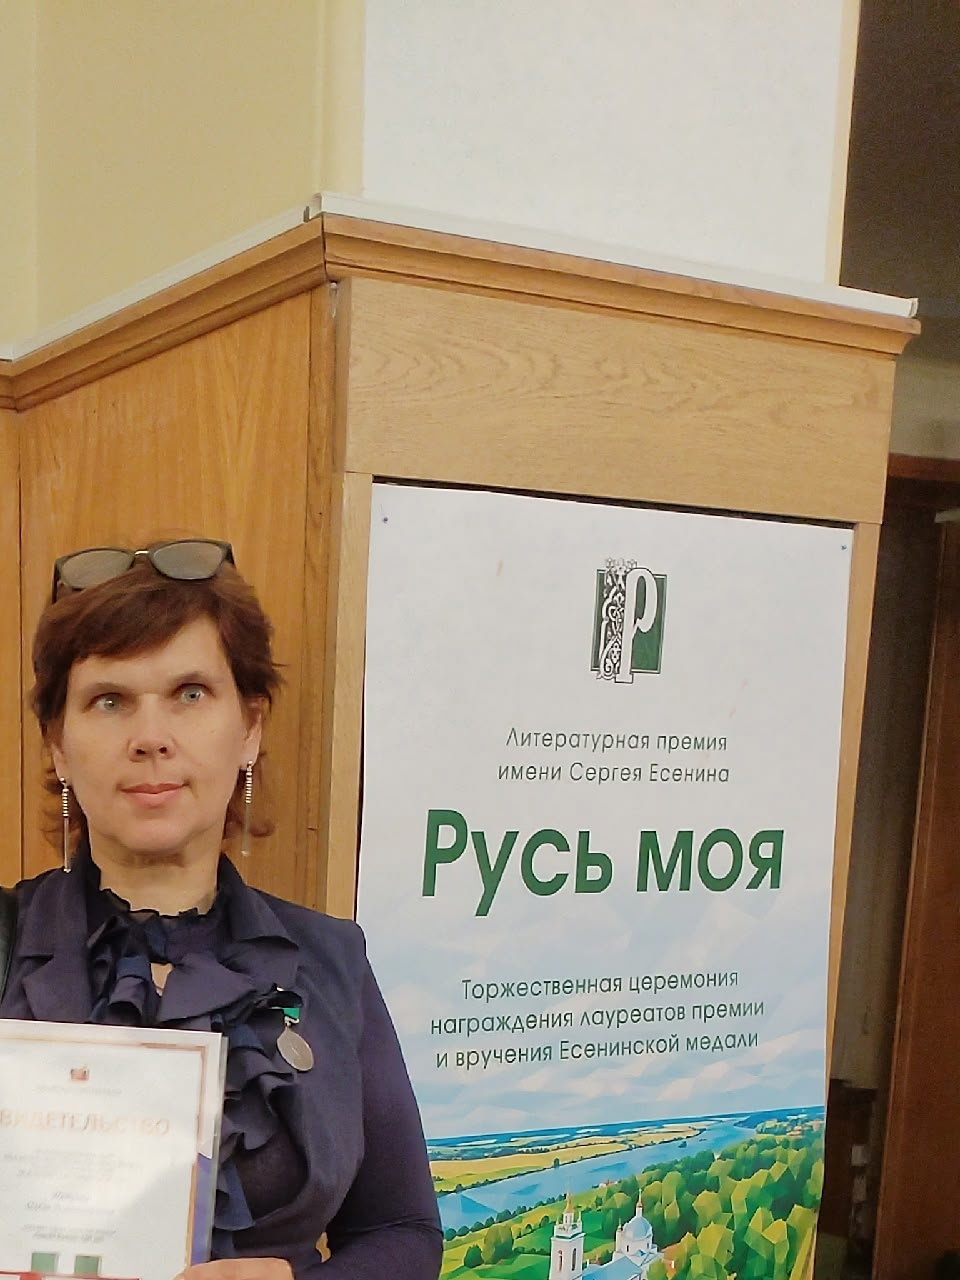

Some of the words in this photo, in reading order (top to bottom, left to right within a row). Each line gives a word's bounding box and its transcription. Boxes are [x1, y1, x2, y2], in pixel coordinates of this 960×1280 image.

[505, 727, 650, 753] Литературная
[656, 735, 727, 754] премия
[498, 765, 562, 781] имени
[569, 762, 642, 785] Сергея
[649, 763, 730, 783] Есенина
[421, 809, 613, 917] Русь
[636, 828, 785, 893] моя
[461, 977, 622, 1004] Торжественная
[629, 972, 738, 995] церемония
[431, 1012, 573, 1038] награждения
[579, 1005, 686, 1029] лауреатов
[692, 1001, 764, 1024] премии
[436, 1052, 448, 1069] и
[456, 1045, 553, 1071] вручения
[560, 1033, 679, 1060] Есенинской
[686, 1032, 758, 1053] медали
